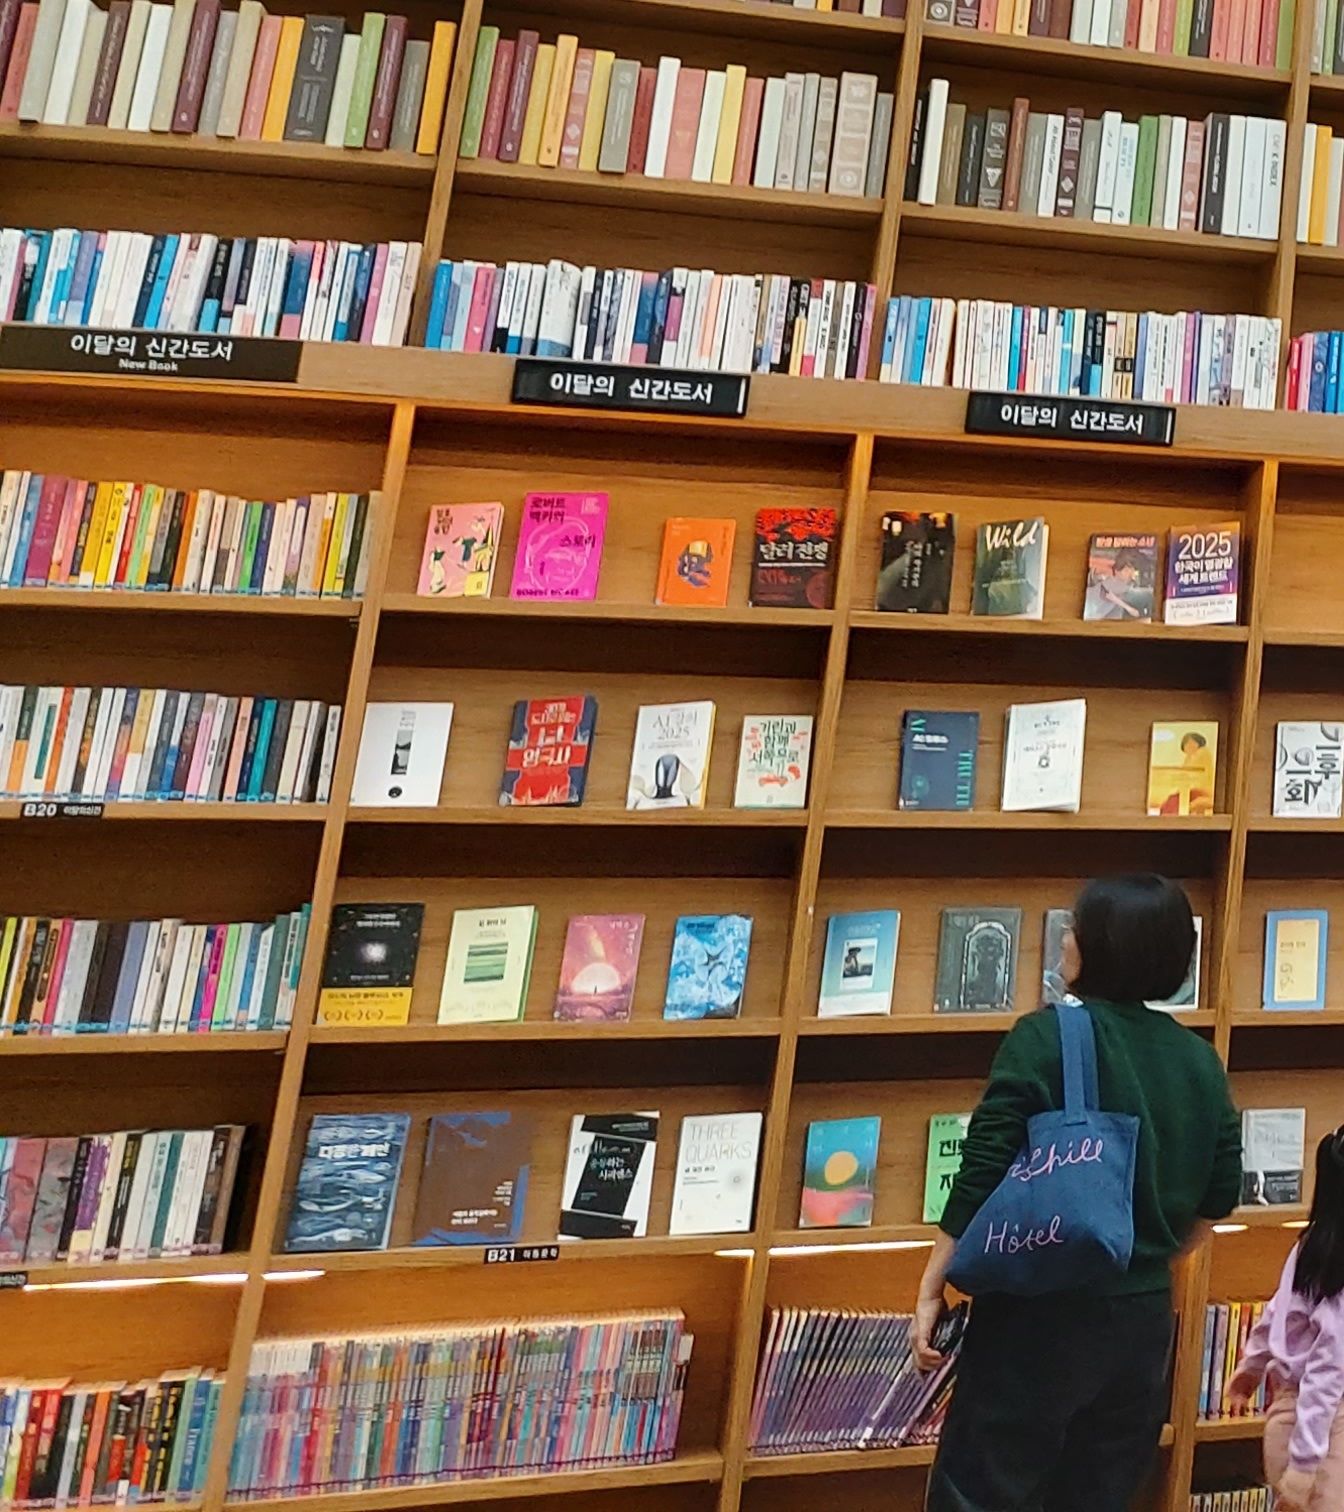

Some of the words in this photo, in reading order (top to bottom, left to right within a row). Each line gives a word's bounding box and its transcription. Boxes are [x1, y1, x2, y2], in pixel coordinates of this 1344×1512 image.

[70, 333, 136, 357] 이달의
[145, 337, 234, 361] 신간도서
[119, 358, 147, 371] New
[148, 360, 178, 373] Book
[550, 372, 615, 397] 이달의
[629, 377, 713, 404] 신간도서
[1000, 404, 1057, 428] 이달의
[1069, 409, 1143, 435] 신간도서
[985, 522, 1038, 551] Wild
[1179, 533, 1232, 559] 2025
[23, 803, 57, 817] B20
[689, 1120, 741, 1141] THREE
[684, 1141, 753, 1164] QUARKS
[984, 1215, 1064, 1254] Hôtel
[487, 1248, 516, 1263] B21
